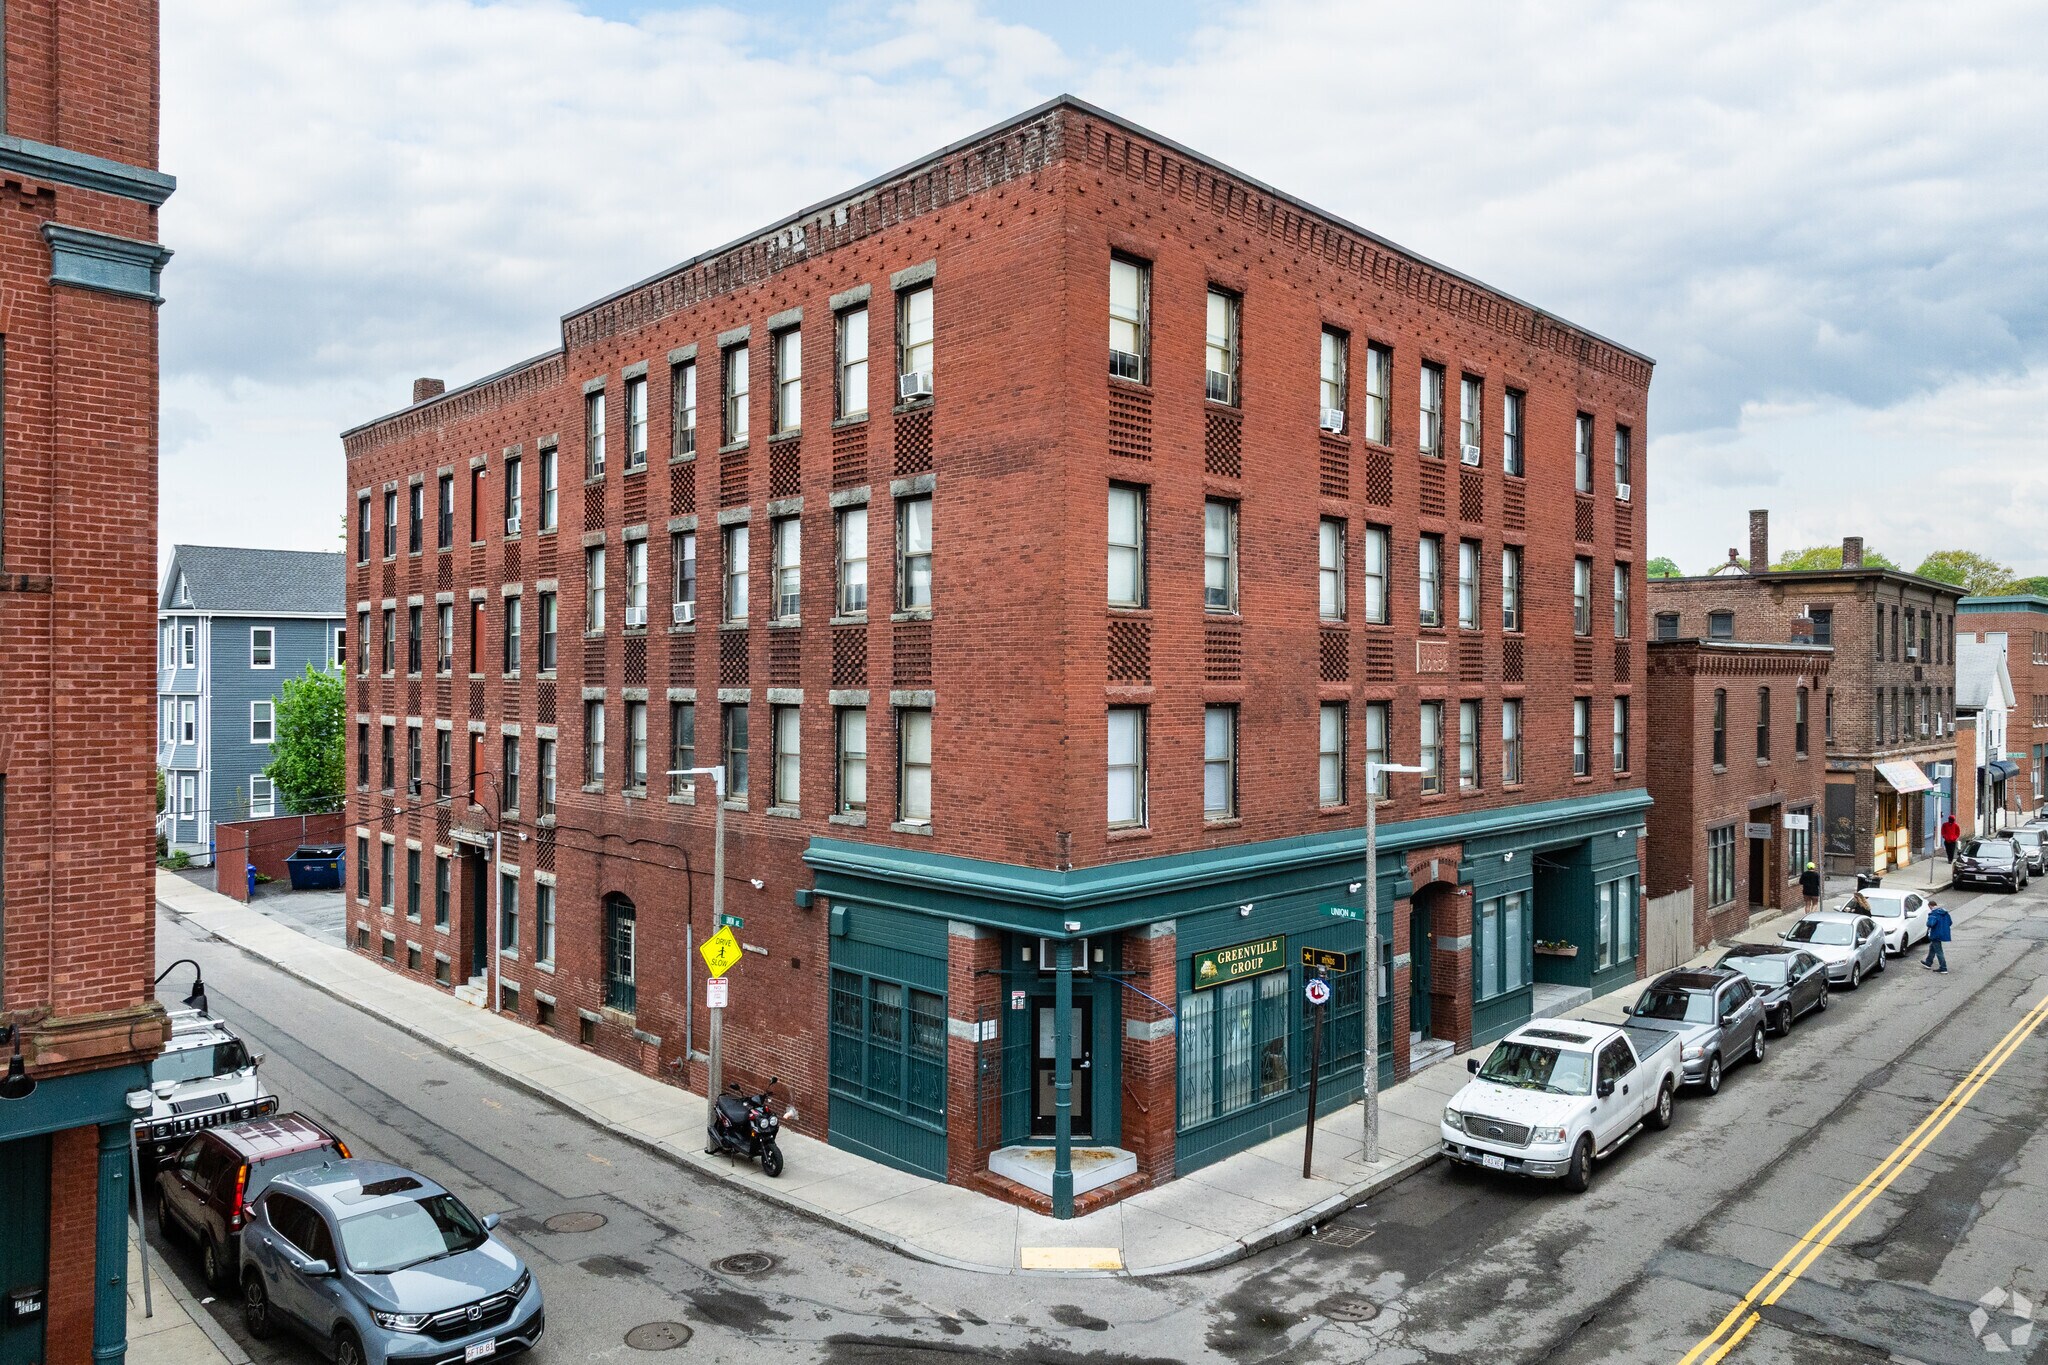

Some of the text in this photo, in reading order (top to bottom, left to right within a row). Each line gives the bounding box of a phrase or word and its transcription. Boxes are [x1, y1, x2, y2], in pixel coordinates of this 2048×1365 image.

[1330, 907, 1349, 917] UNION
[715, 937, 732, 947] DRIVE
[1217, 940, 1278, 964] GREENVILLE
[711, 958, 727, 967] SLOW
[1230, 957, 1263, 975] GROUP
